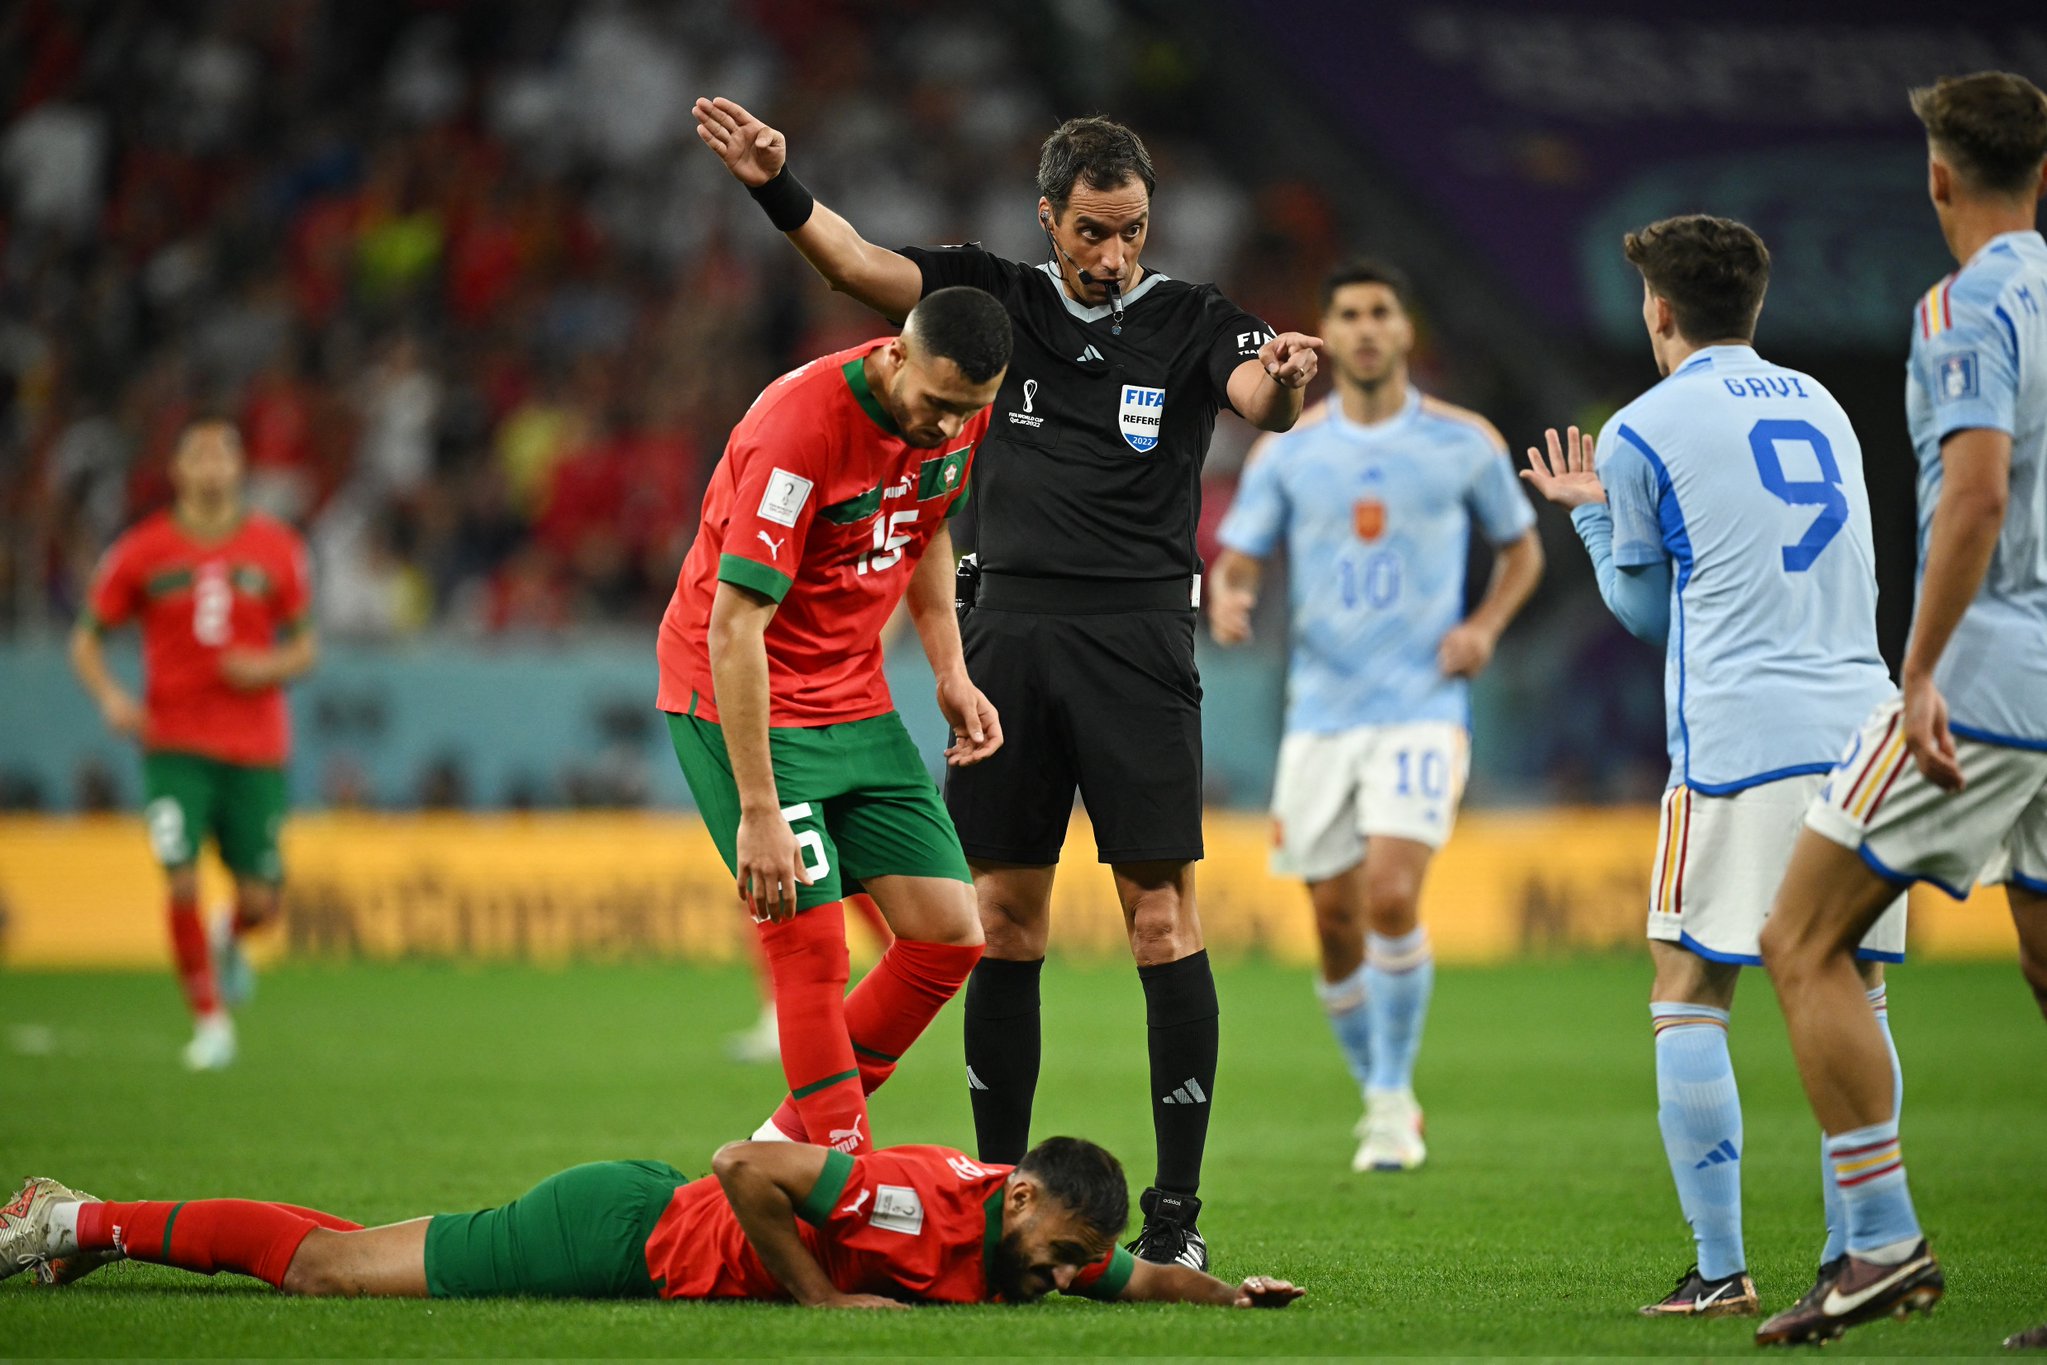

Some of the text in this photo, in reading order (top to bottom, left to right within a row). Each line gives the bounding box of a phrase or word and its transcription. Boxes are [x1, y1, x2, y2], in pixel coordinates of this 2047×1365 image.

[1125, 389, 1165, 407] FIFA
[1723, 376, 1809, 399] GAVI
[1123, 414, 1160, 426] REFERE
[1132, 437, 1153, 446] 2022
[1748, 419, 1849, 572] 9
[857, 509, 919, 576] 15
[1338, 551, 1402, 609] 10
[1393, 749, 1447, 798] 10
